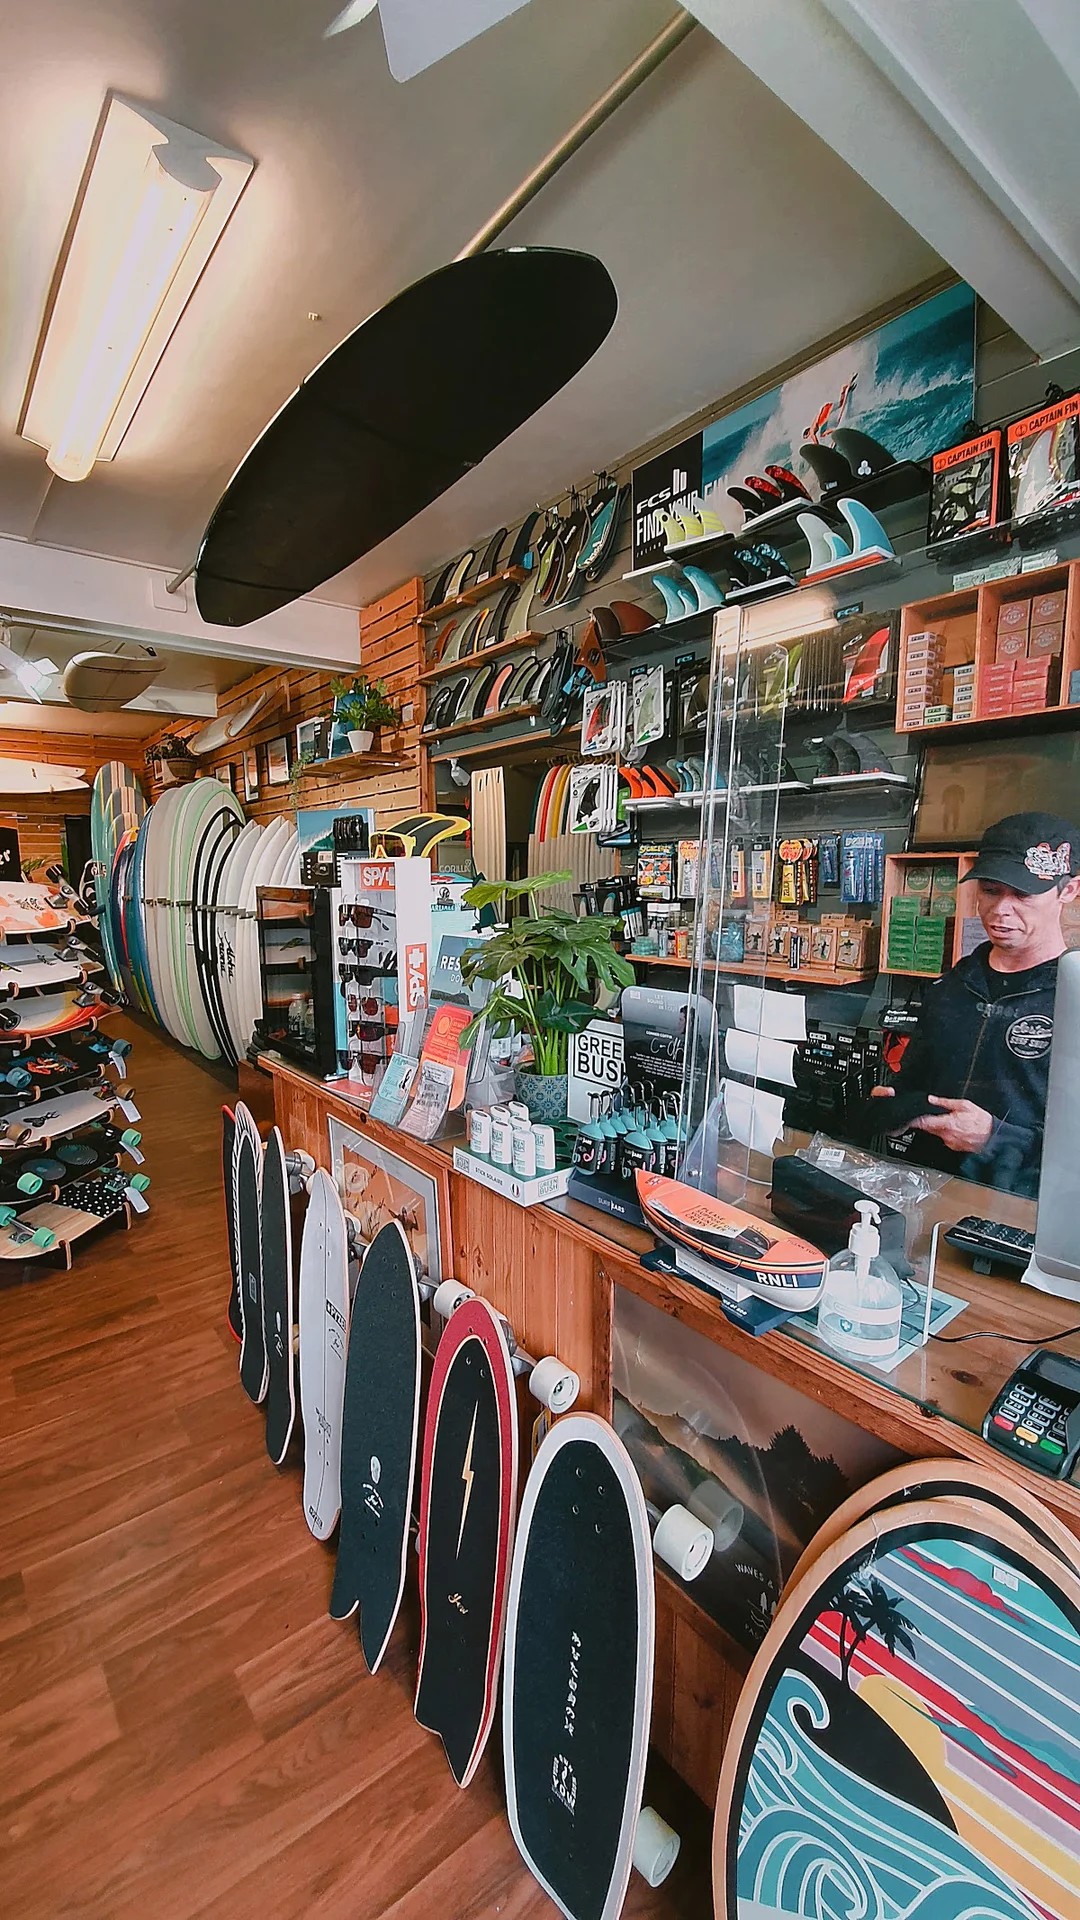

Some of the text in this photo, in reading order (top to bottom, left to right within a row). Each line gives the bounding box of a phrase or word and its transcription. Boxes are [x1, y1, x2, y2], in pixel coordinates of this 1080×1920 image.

[1029, 400, 1079, 431] CAPTAIN FIN
[948, 438, 993, 465] CAPTAIN FIN
[637, 487, 671, 514] FCS
[677, 655, 693, 664] FCS
[632, 667, 646, 675] FCS
[783, 871, 793, 897] Solarez
[224, 931, 236, 984] Aloha
[441, 955, 461, 971] RES
[578, 1034, 622, 1062] GREE
[813, 1048, 834, 1057] FCS
[578, 1051, 624, 1082] BUS
[685, 1213, 706, 1227] CREWS
[701, 1207, 726, 1221] PLEASE
[756, 1271, 799, 1288] RNLI
[735, 1563, 765, 1582] WAVES
